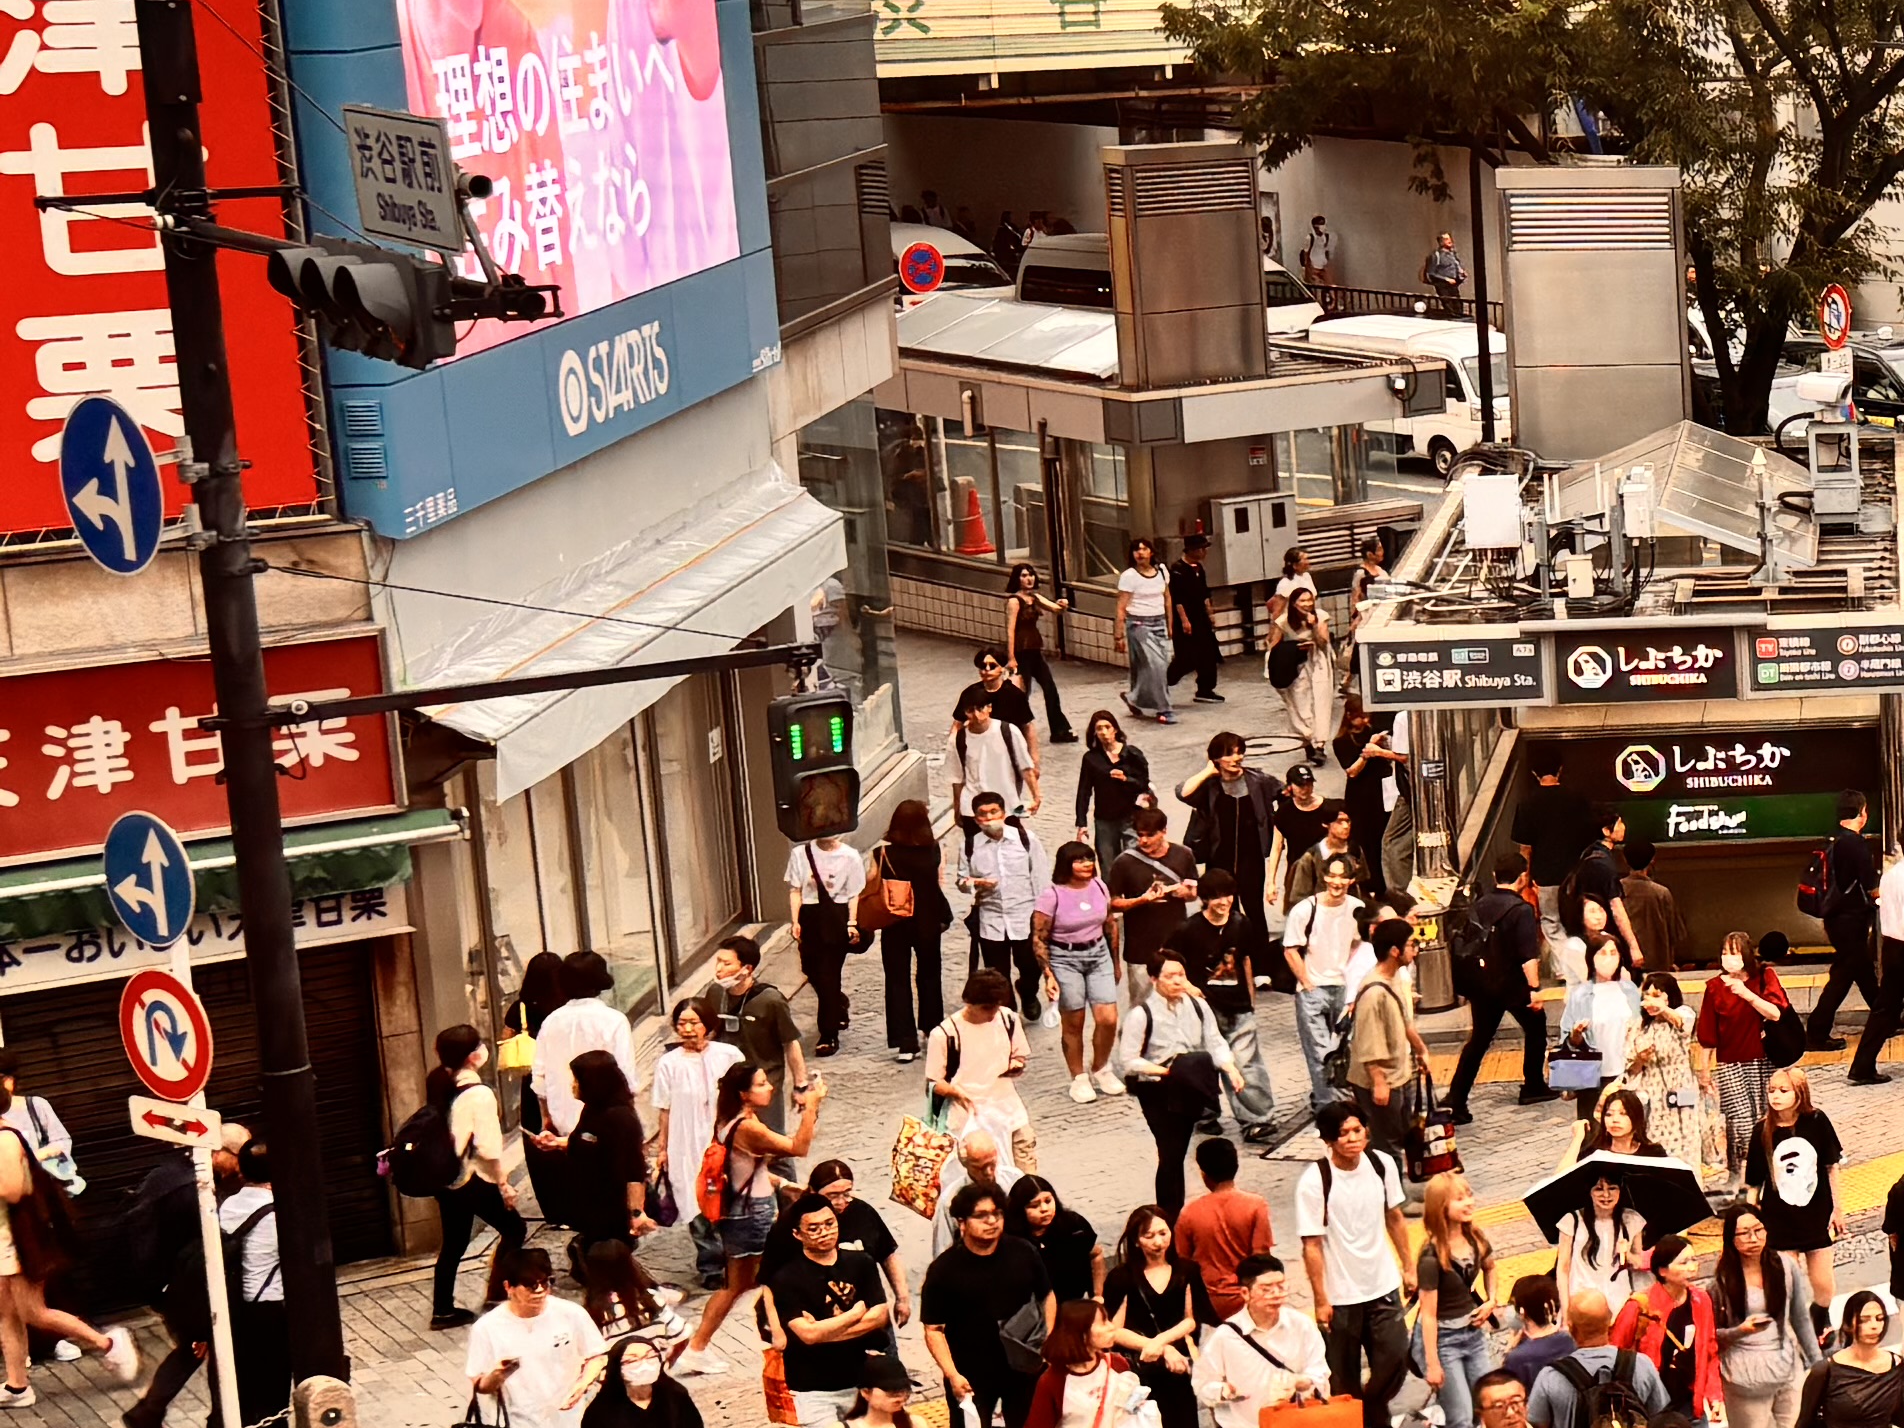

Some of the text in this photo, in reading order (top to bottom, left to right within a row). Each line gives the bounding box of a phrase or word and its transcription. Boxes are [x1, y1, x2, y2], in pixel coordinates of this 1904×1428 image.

[430, 32, 677, 163] 理想の住まいへ
[353, 126, 444, 193] 渋谷駅前
[377, 191, 442, 232] Shibuya Sta.
[589, 320, 669, 423] STARTS
[1617, 644, 1723, 672] しぶちか
[1403, 670, 1463, 689] 渋谷駅
[1465, 674, 1537, 689] Shibuya Sta.
[1630, 673, 1707, 686] SHIBUCHIKA
[0, 688, 361, 808] 津甘栗
[1672, 742, 1791, 772] しぶちか
[1686, 775, 1773, 789] SHIBUCHIKA
